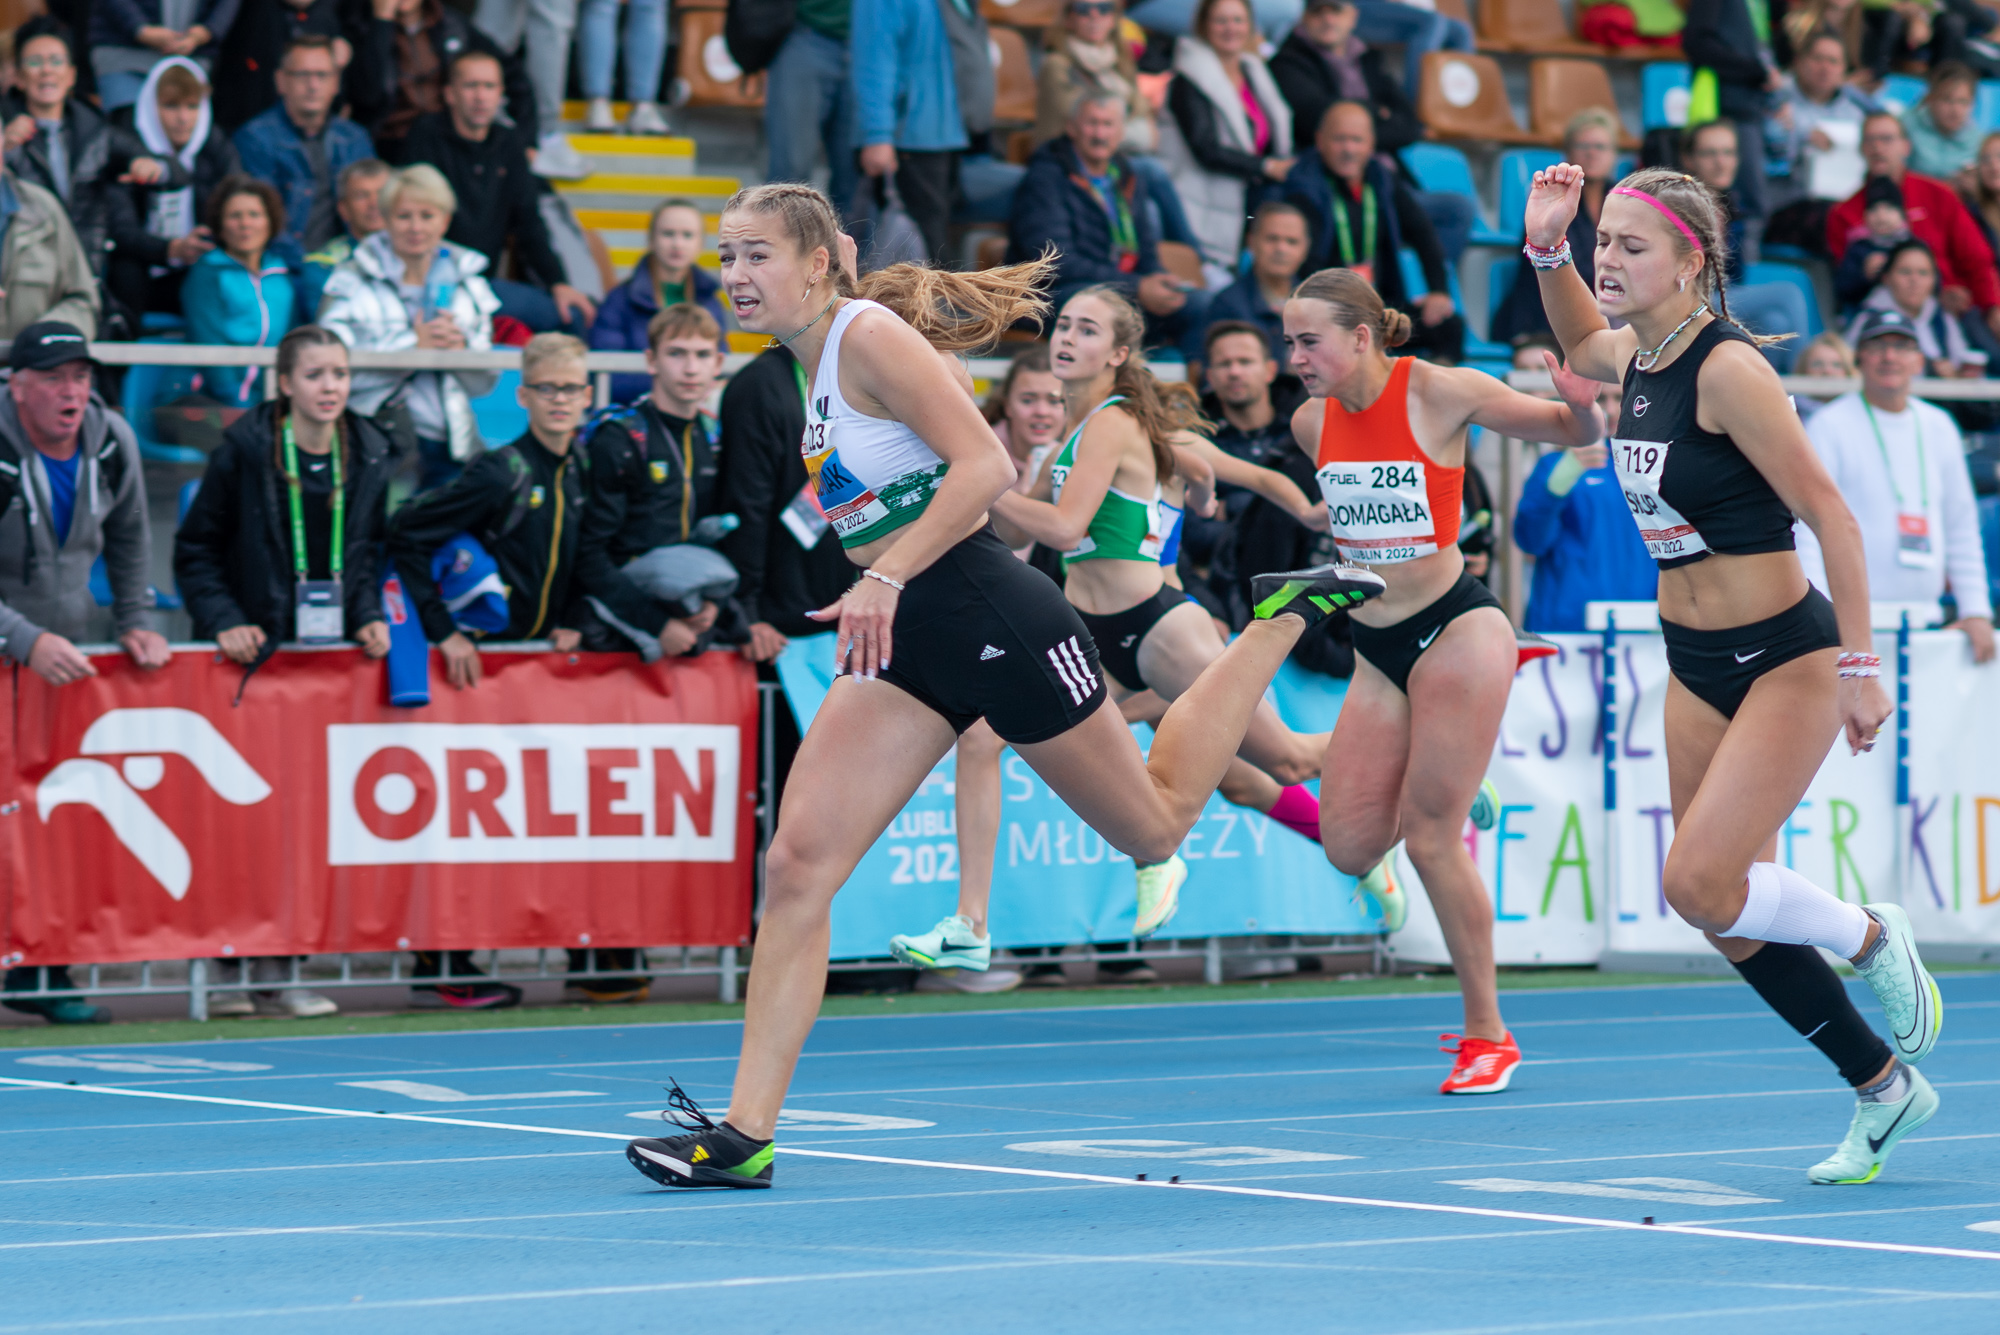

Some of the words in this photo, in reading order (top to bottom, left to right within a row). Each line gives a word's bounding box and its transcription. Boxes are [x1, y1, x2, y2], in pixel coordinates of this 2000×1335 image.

[1623, 445, 1659, 474] 719
[1329, 474, 1361, 485] FUEL
[1371, 466, 1418, 488] 284
[844, 511, 868, 530] 2022
[1328, 502, 1428, 526] DOMAGAŁA
[1349, 549, 1381, 561] LUBLIN
[1385, 547, 1416, 560] 2022
[353, 745, 715, 841] ORLEN
